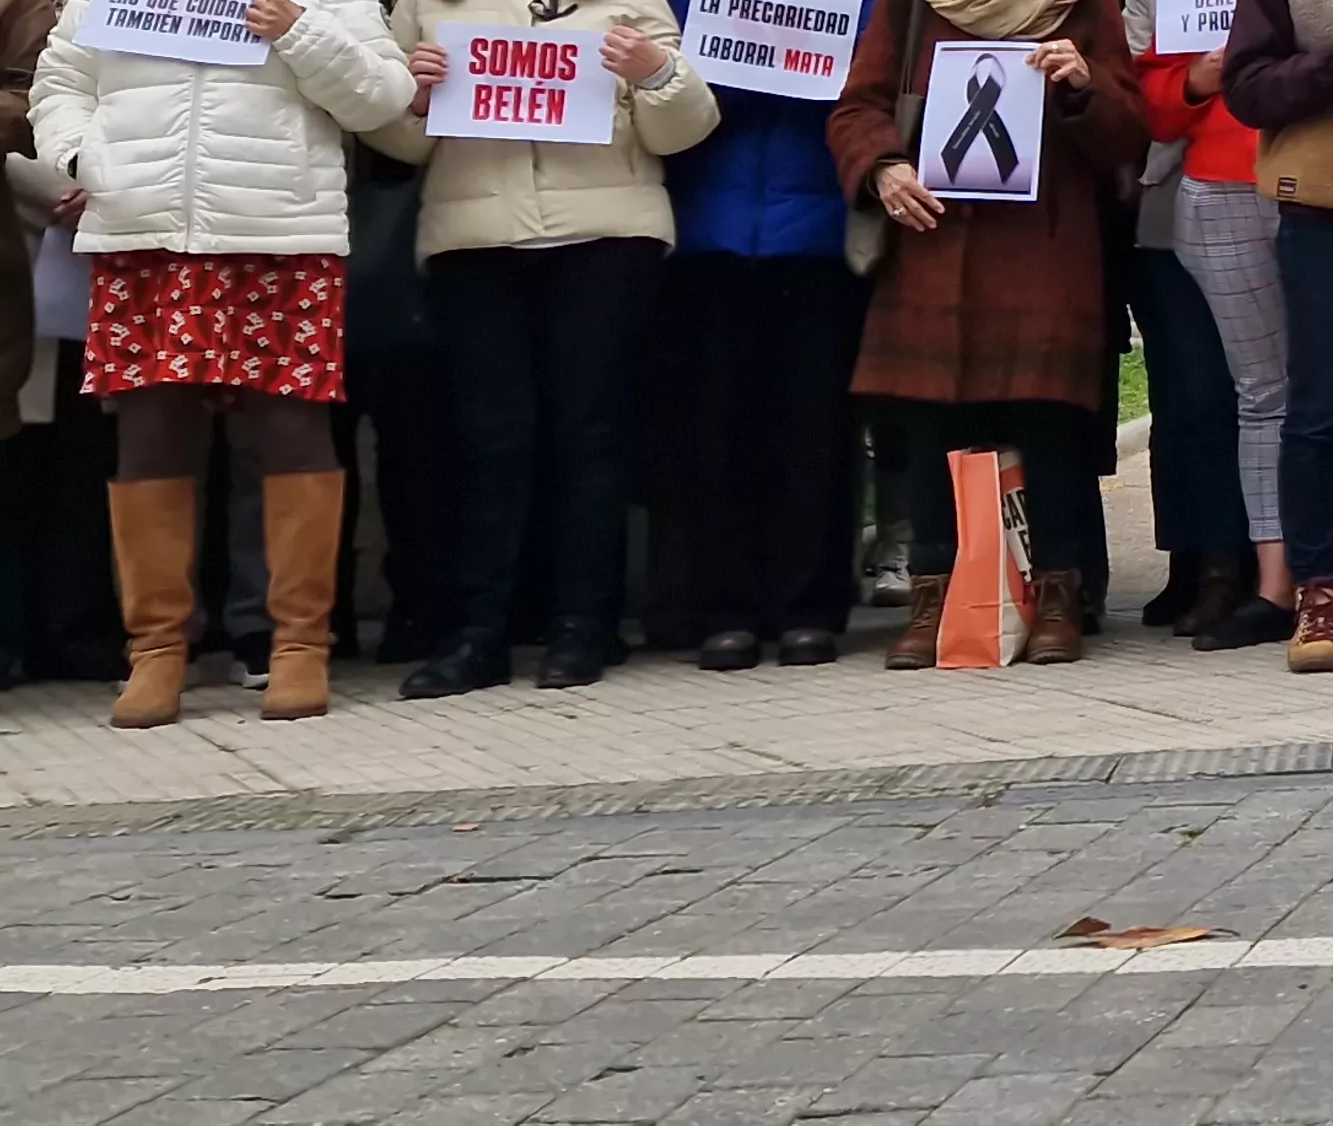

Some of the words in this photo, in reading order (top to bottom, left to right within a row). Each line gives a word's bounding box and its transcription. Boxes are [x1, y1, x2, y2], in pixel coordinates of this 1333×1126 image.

[106, 7, 183, 35] TAMBIÉN
[468, 37, 579, 82] SOMOS
[699, 34, 776, 69] LABORAL
[783, 48, 836, 78] MATA
[471, 81, 566, 126] BELÉN
